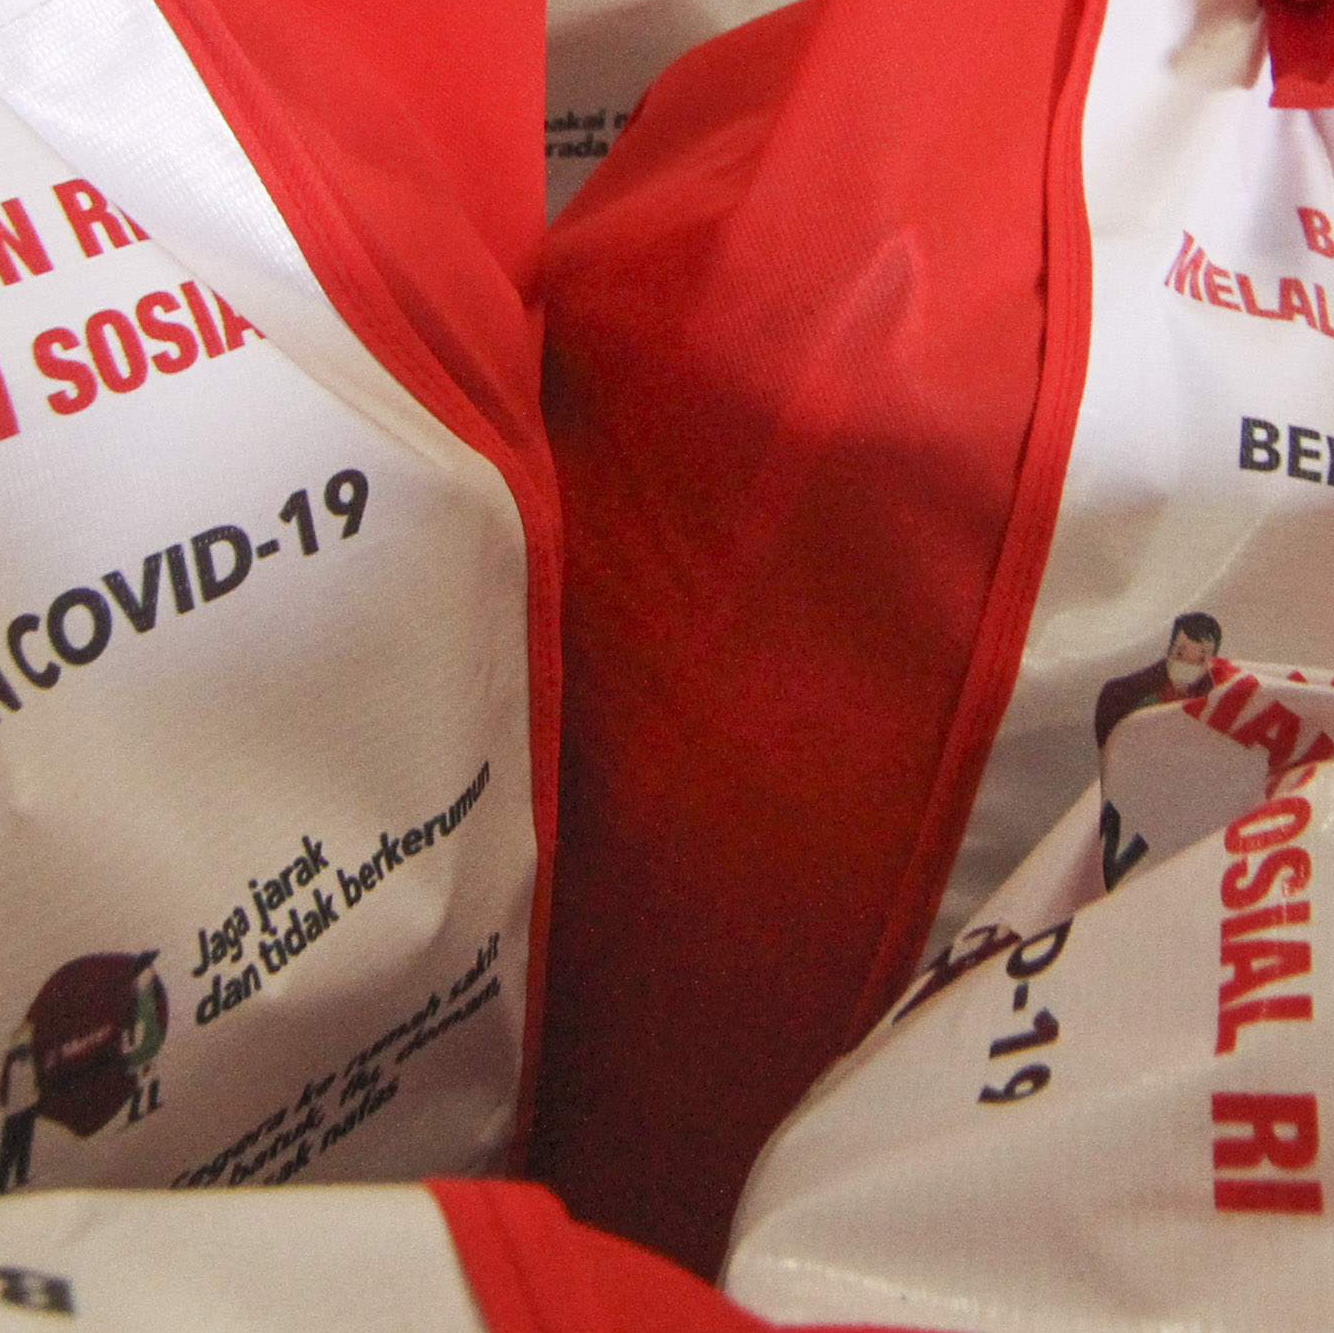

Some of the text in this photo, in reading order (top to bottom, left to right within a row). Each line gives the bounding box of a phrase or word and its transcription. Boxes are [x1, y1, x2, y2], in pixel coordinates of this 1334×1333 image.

[7, 468, 370, 689] COVID-19
[192, 835, 330, 979] Jaga jarak
[196, 963, 262, 1026] dan
[258, 888, 340, 975] tidak
[1211, 1092, 1324, 1215] RI
